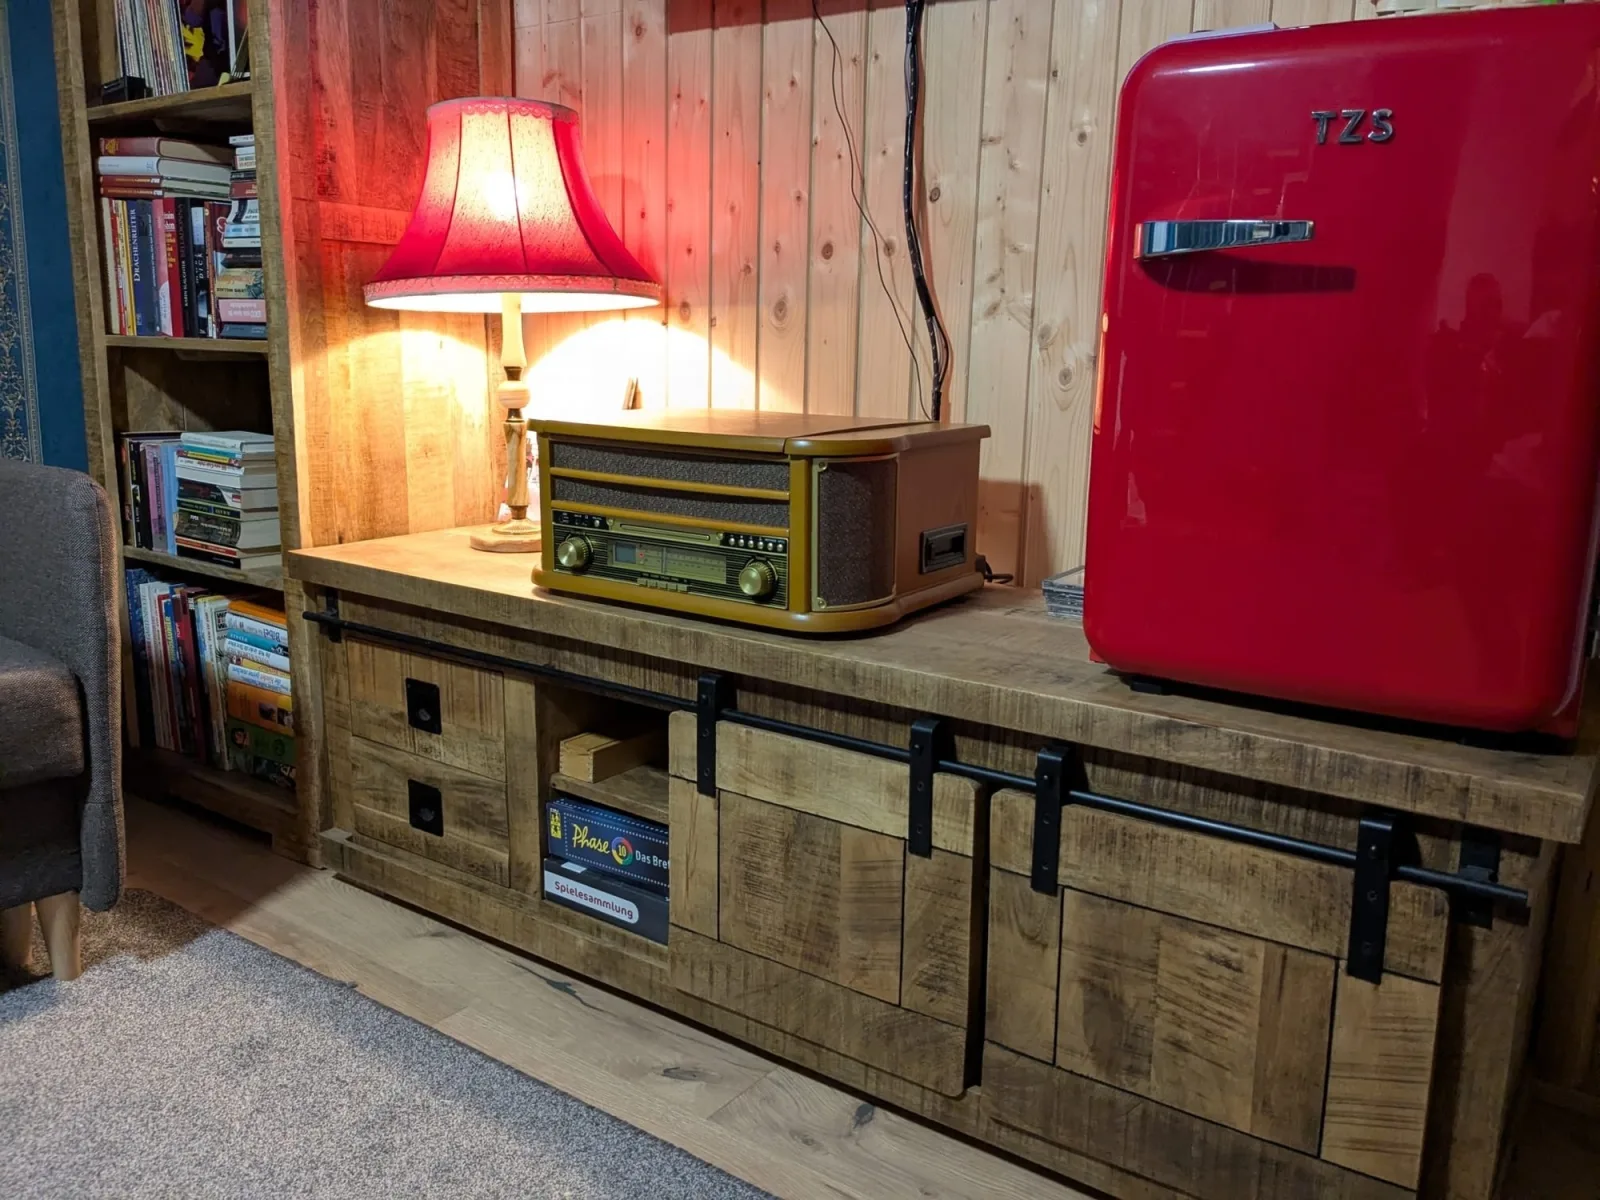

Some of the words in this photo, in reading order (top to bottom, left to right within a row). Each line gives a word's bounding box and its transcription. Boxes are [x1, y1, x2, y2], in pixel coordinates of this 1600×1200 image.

[1311, 108, 1393, 144] TZS
[130, 208, 141, 282] DRACHENREITER
[571, 823, 610, 854] Phase
[618, 844, 627, 858] 10
[635, 850, 651, 864] Das
[554, 880, 634, 920] Spielesammlung
